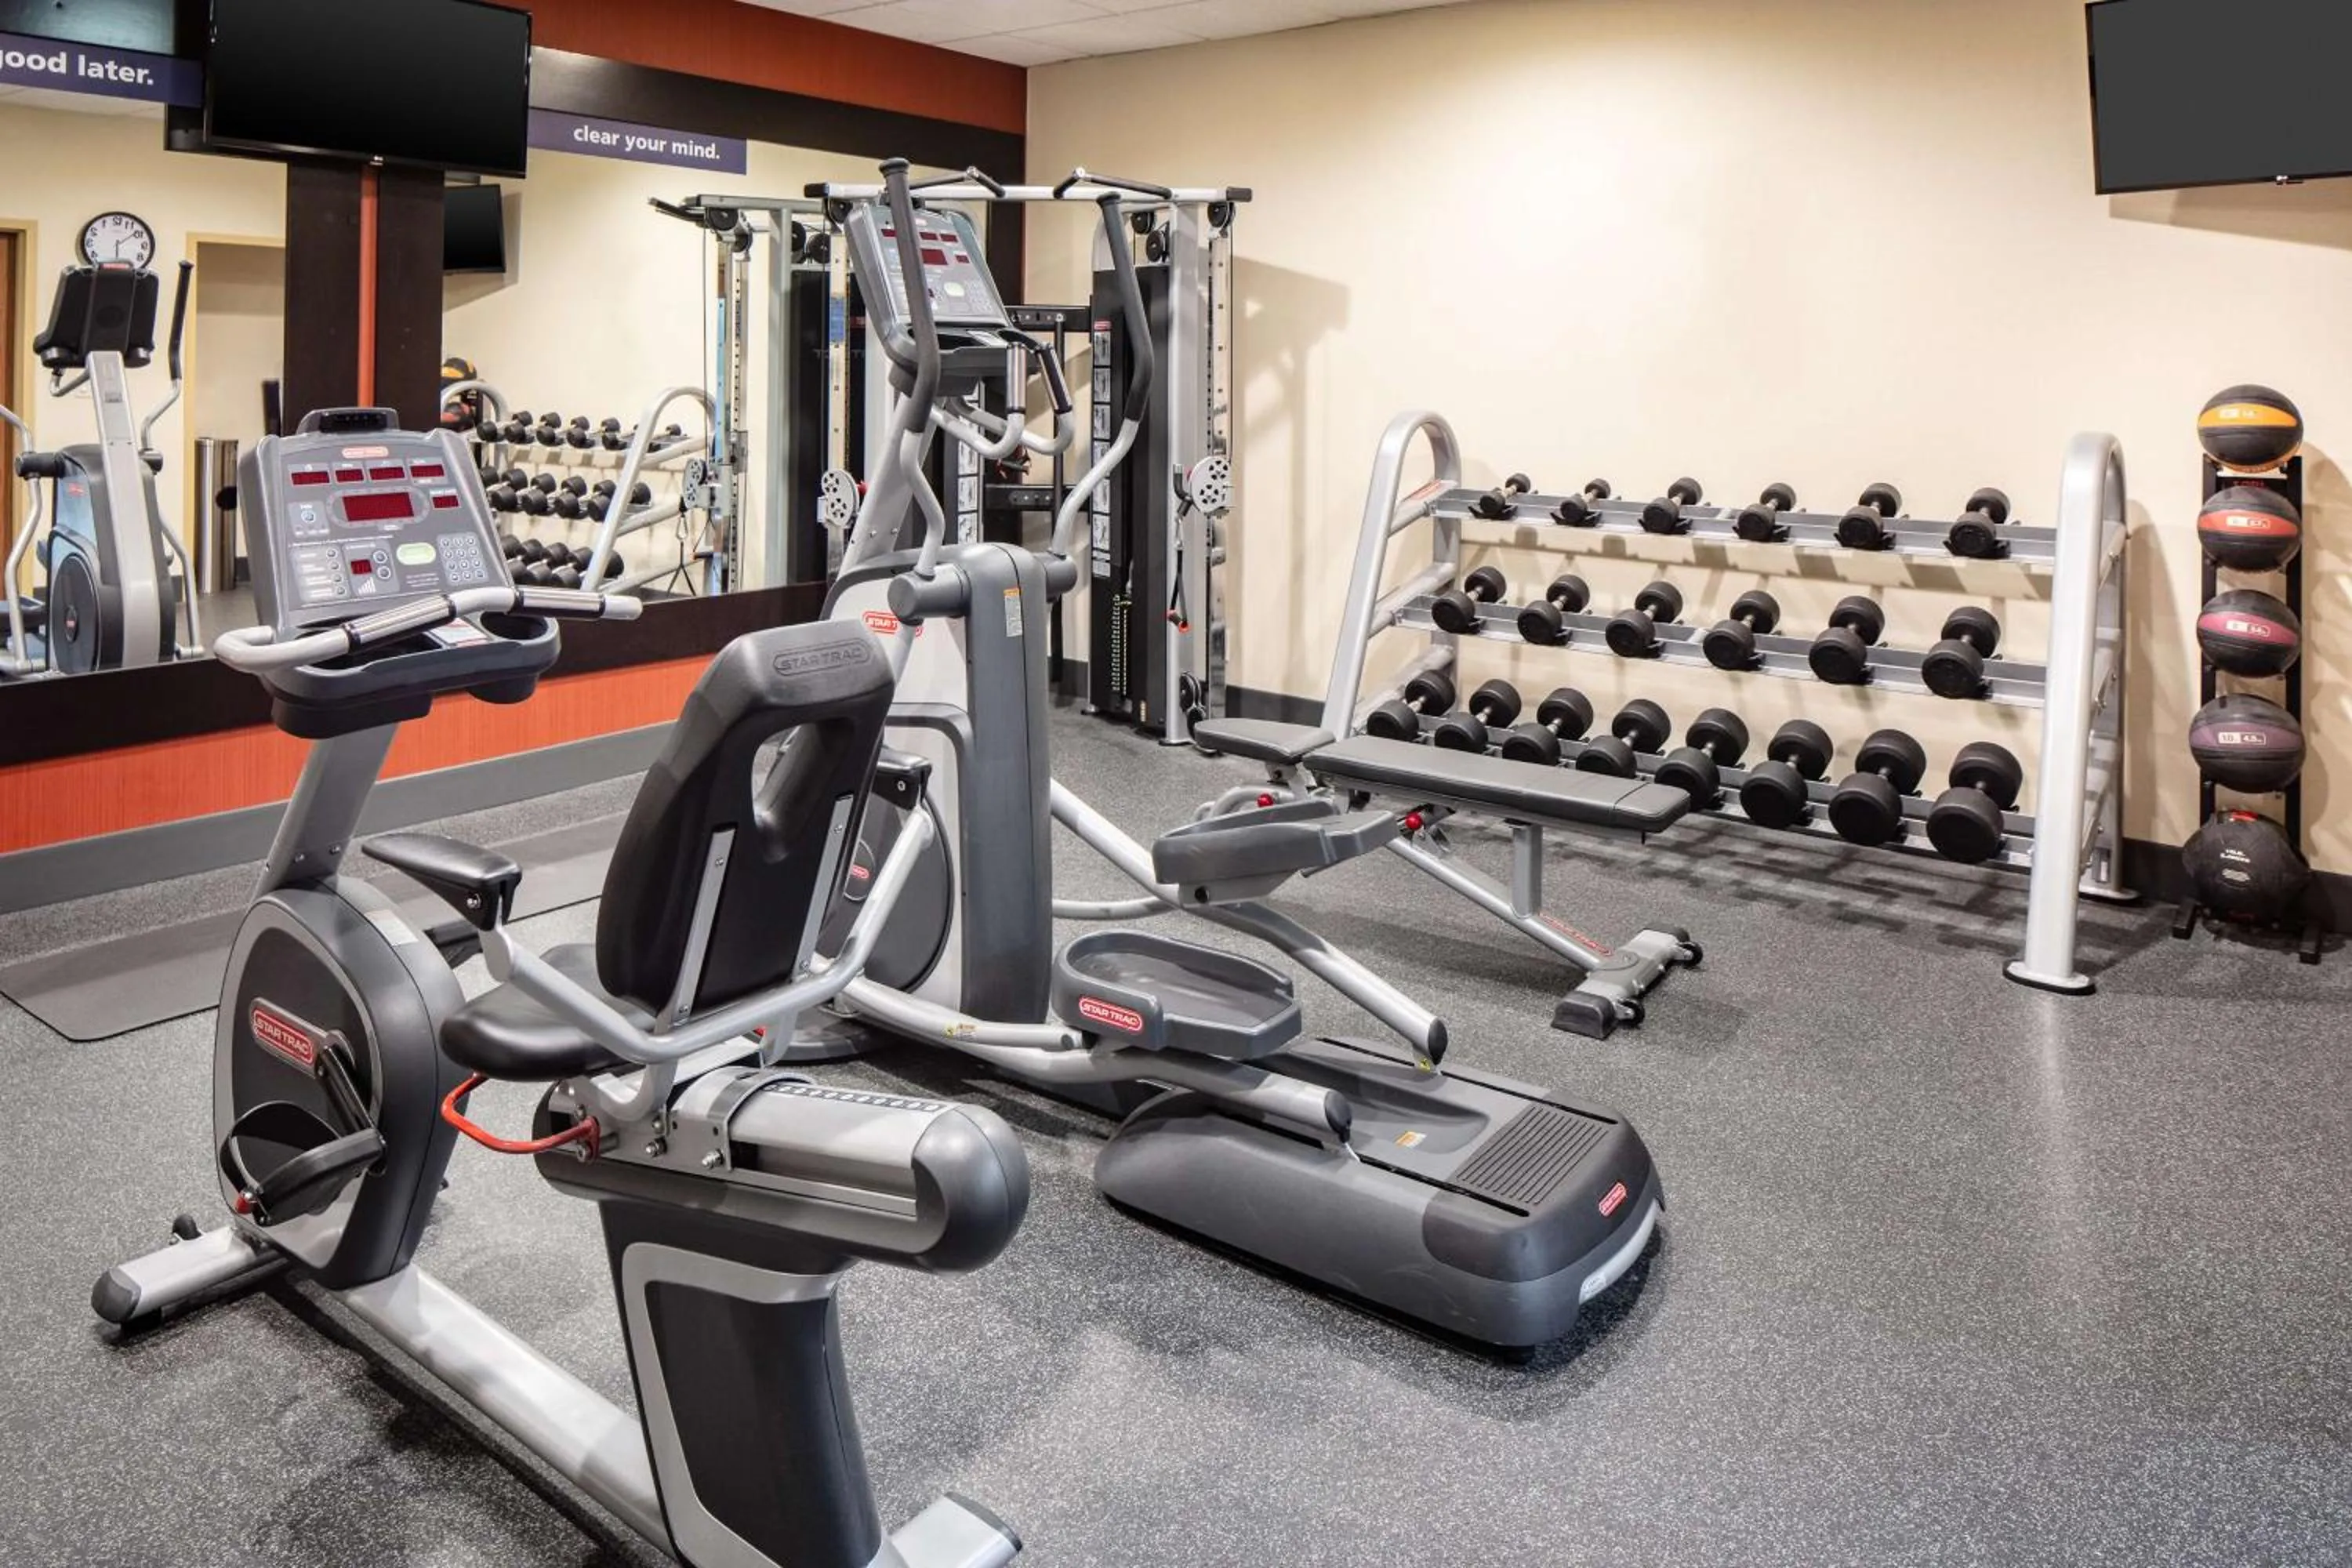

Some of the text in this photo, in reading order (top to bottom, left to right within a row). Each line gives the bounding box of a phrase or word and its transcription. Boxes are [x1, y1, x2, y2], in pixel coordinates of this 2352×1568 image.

[0, 49, 154, 85] ood later.
[573, 125, 720, 159] clear your mind.
